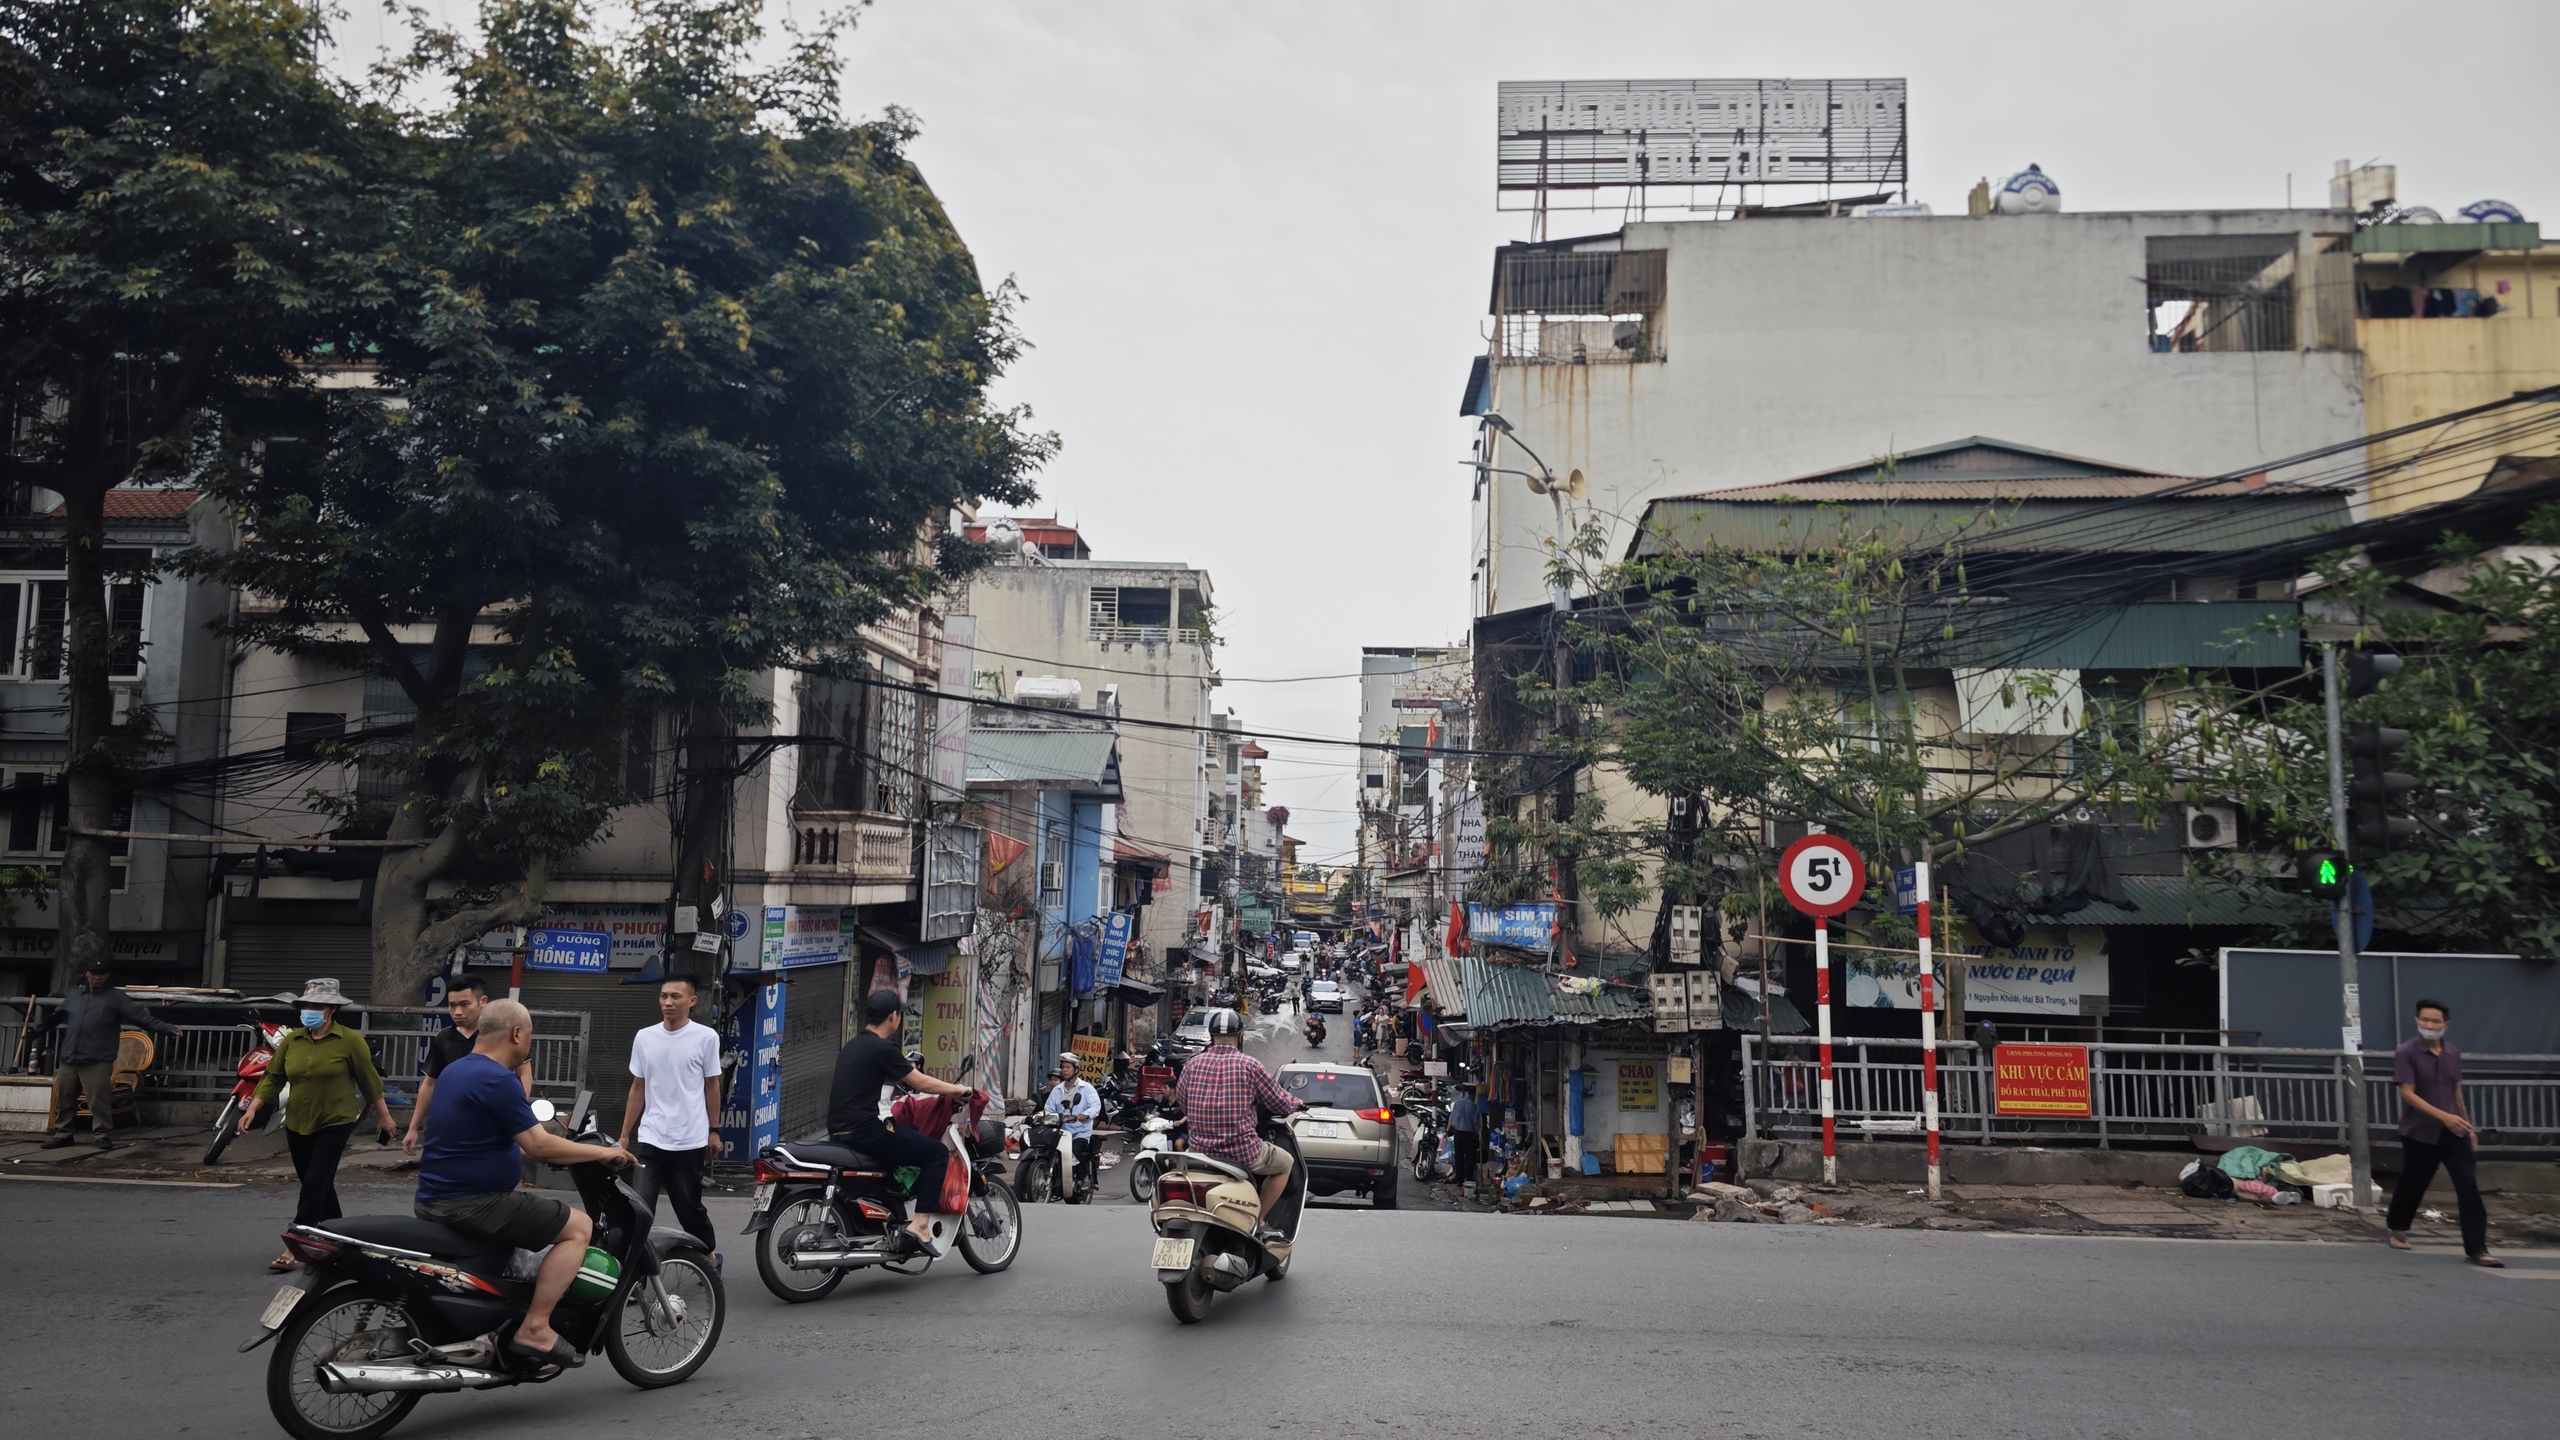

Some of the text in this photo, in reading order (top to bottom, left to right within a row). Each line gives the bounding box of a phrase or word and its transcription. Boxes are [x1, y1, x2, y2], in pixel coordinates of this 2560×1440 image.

[947, 668, 965, 687] TIM
[1461, 820, 1482, 828] NHA
[1457, 836, 1485, 844] KHOA
[798, 914, 813, 932] THUỐC
[1505, 911, 1535, 921] SIM
[8, 935, 55, 956] TRỌ
[556, 934, 601, 947] ĐƯỜNG
[700, 938, 715, 946] 200K
[1104, 937, 1126, 948] THUỐC
[533, 944, 601, 967] HỒNG HÀ
[2008, 945, 2050, 962] SINH
[2053, 943, 2077, 963] TỐ
[1968, 963, 2013, 981] NƯỚC
[2015, 963, 2039, 981] ÉP
[2034, 995, 2044, 1005] Bà
[2068, 996, 2078, 1006] Hà
[936, 1002, 964, 1020] TIM
[762, 1013, 778, 1036] NHÀ
[937, 1031, 960, 1052] GÀ
[1073, 1037, 1107, 1054] BÚN CHẢ
[1079, 1053, 1105, 1064] ÁNH
[1079, 1062, 1104, 1074] UỐN
[1619, 1061, 1655, 1078] CHÁO
[1999, 1060, 2086, 1083] KHU VỰC CẤM
[2013, 1085, 2029, 1097] RÁC
[2051, 1085, 2067, 1098] PHẾ
[2067, 1086, 2086, 1098] THẢI
[754, 1096, 778, 1128] CHUẨN
[1154, 1253, 1188, 1267] 250.44
